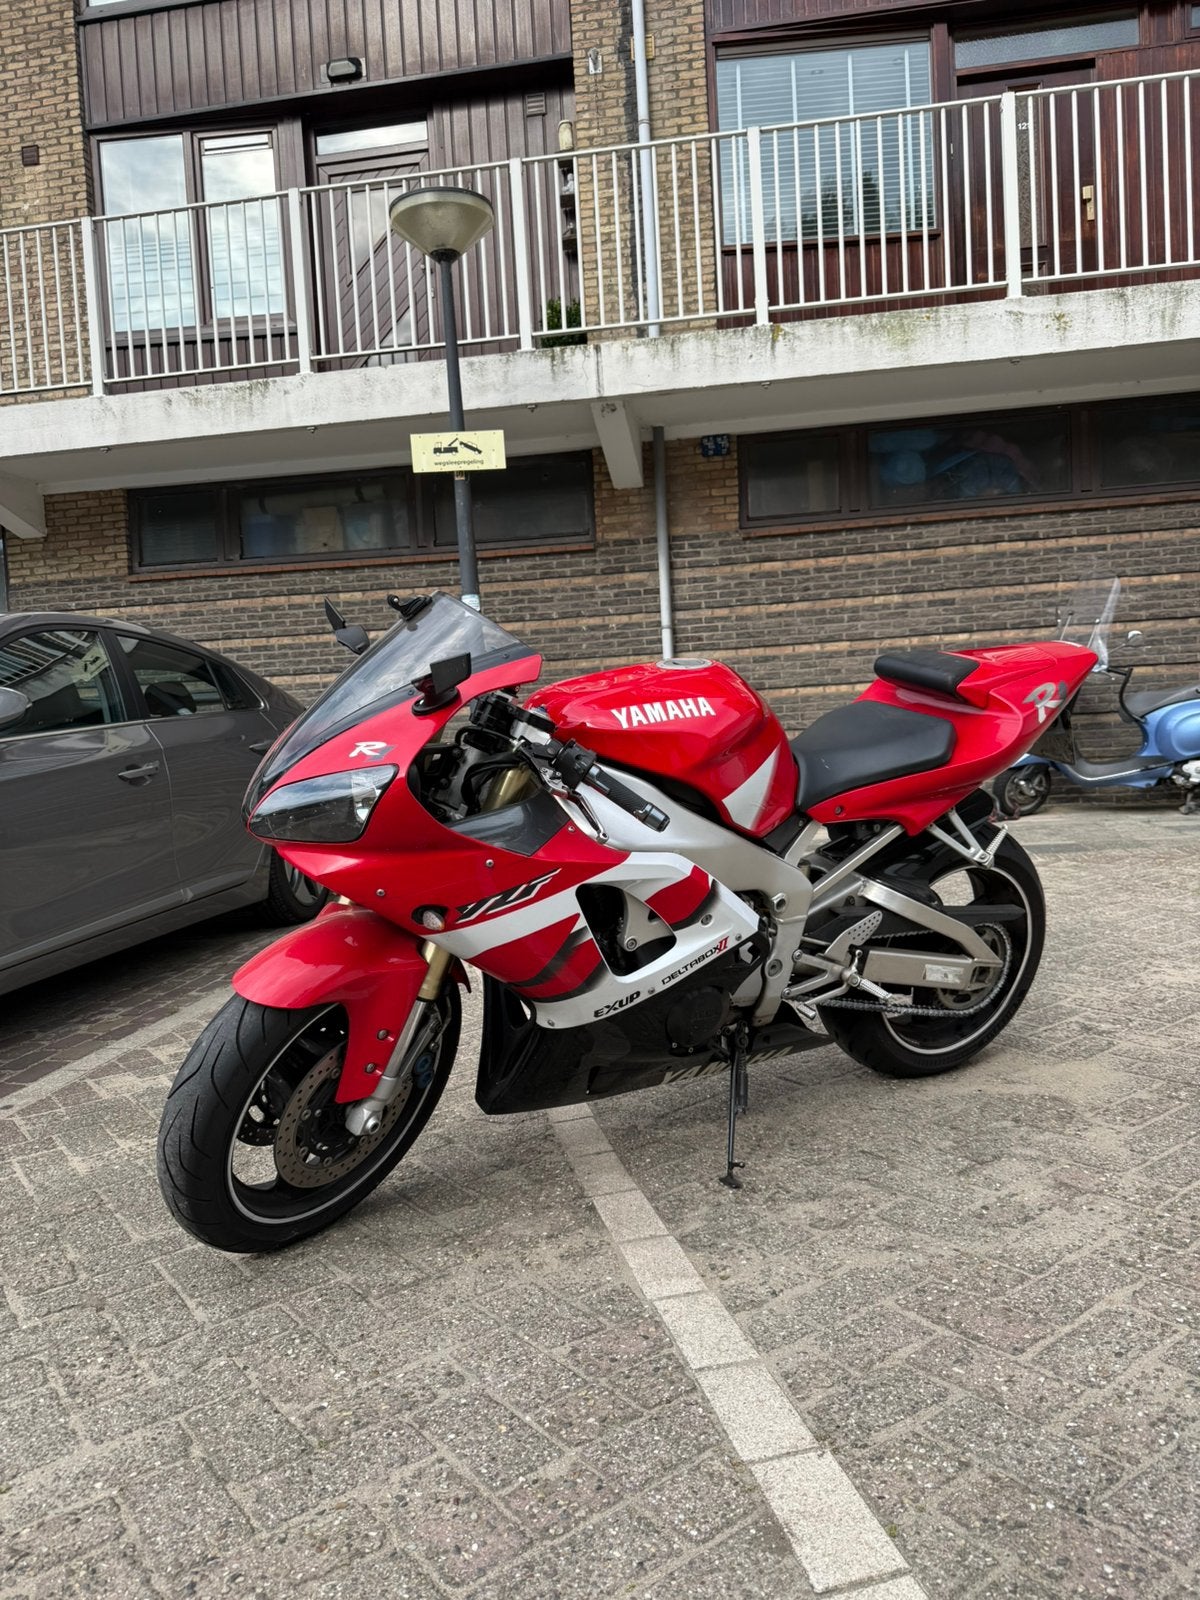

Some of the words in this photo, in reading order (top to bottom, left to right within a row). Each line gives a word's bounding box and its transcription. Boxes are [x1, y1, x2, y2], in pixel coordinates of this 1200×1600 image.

[610, 696, 717, 730] YAMAHA
[593, 990, 641, 1018] EXUP
[661, 1044, 794, 1085] YAMHA
